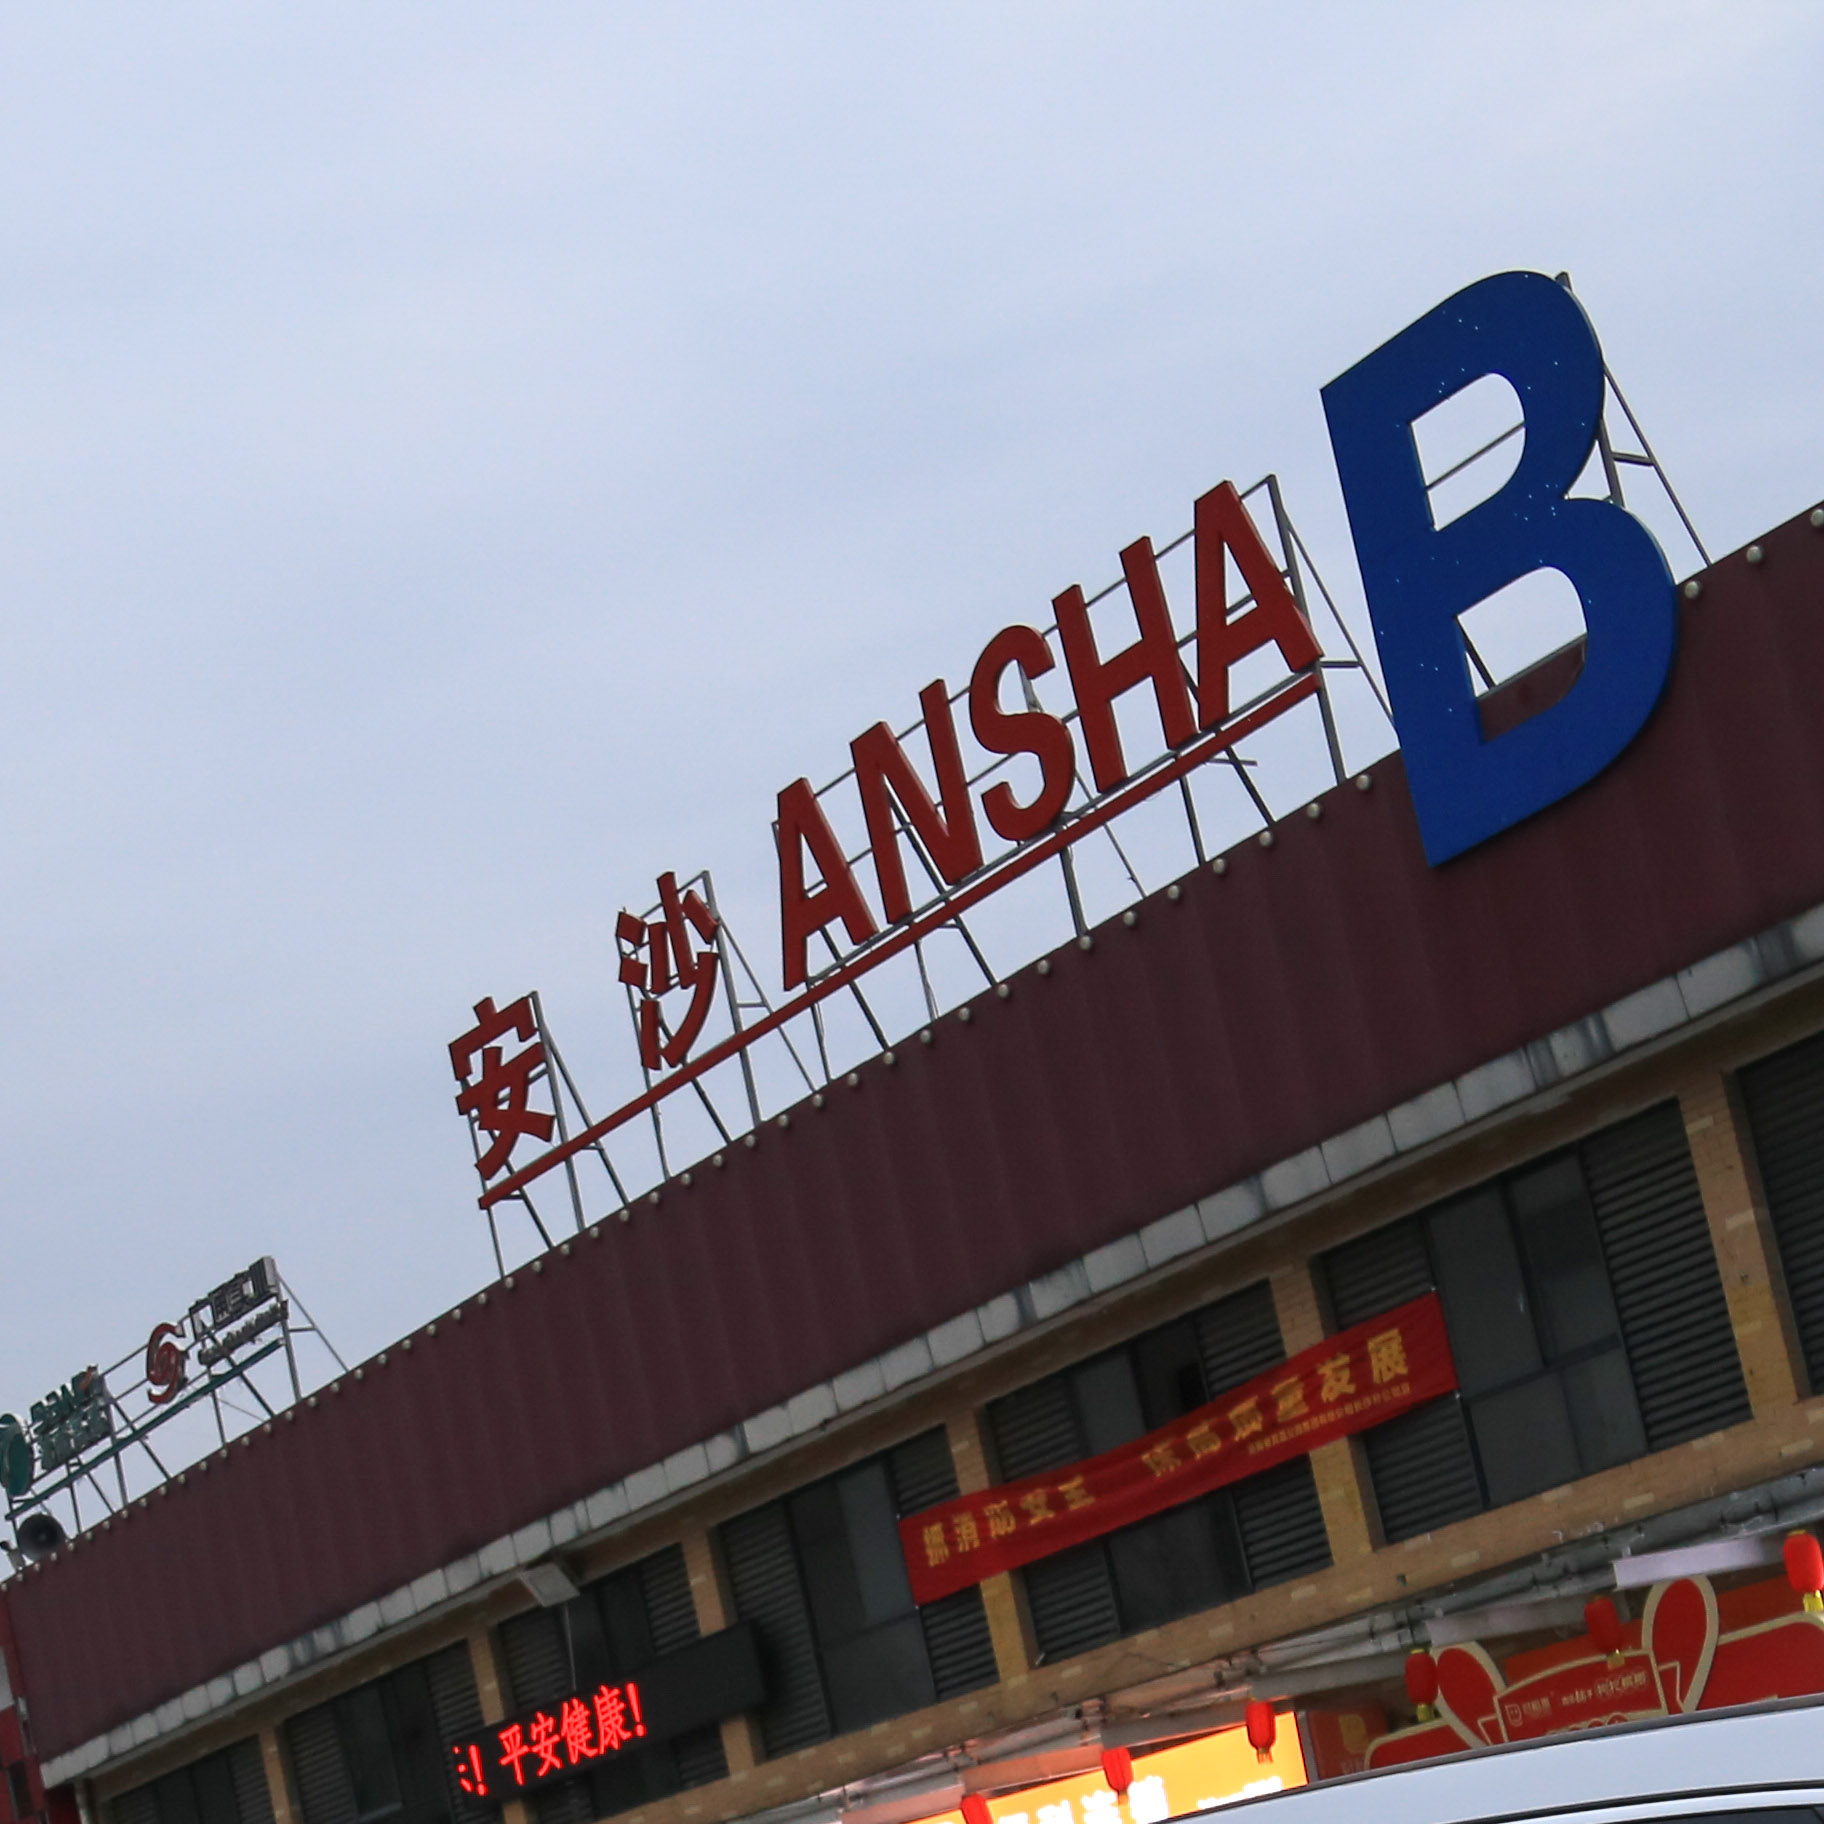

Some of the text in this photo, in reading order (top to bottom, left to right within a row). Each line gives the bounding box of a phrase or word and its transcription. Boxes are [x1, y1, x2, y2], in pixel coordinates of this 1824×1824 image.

[448, 480, 1323, 1181] 安沙 ANSHA
[1320, 270, 1678, 867] B
